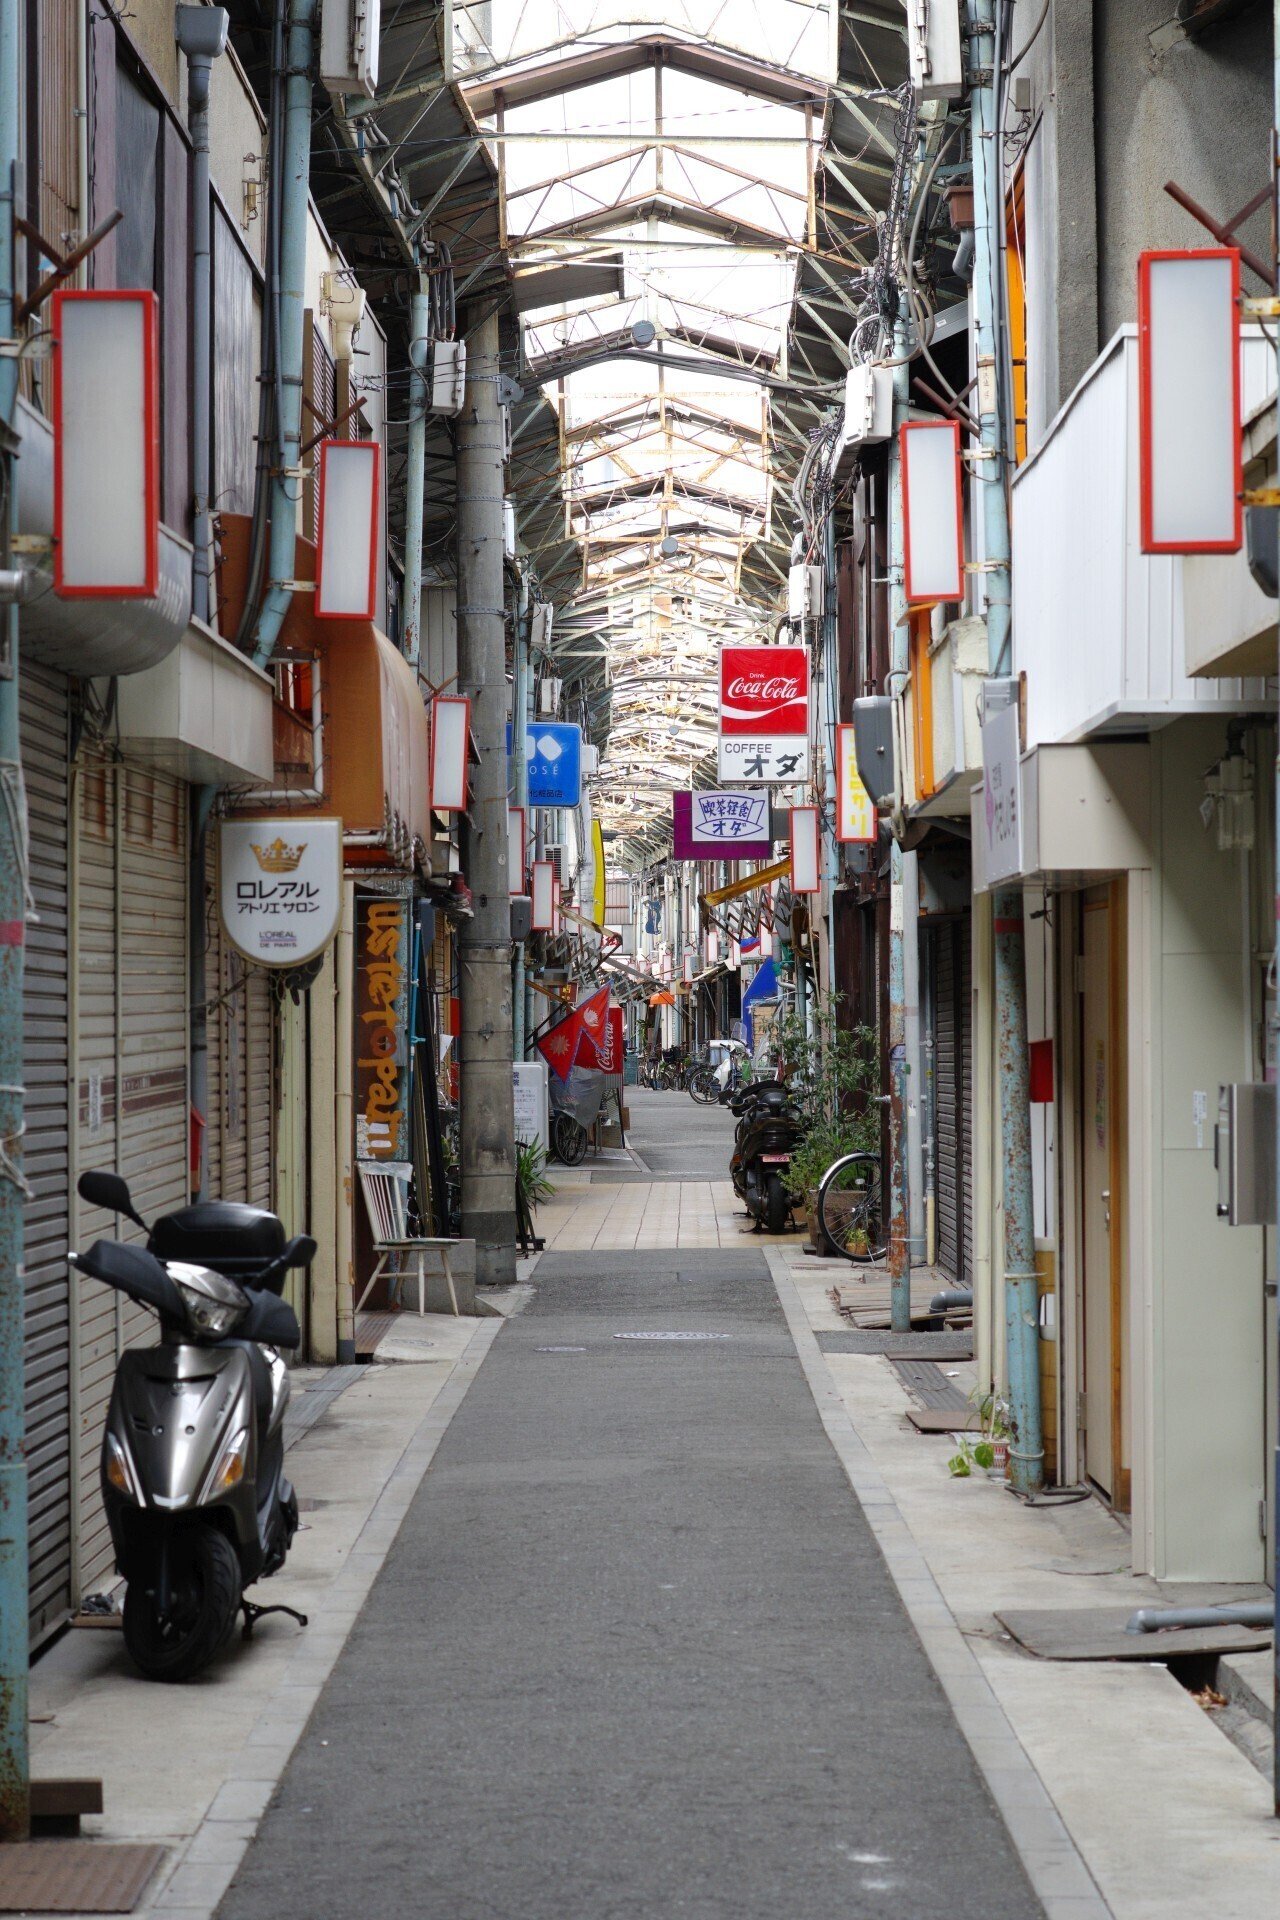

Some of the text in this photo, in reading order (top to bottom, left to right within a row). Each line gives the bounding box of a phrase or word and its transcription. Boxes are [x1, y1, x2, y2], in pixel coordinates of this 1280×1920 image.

[727, 677, 801, 699] Coca-Cola
[725, 743, 772, 753] COFFEE
[529, 764, 558, 775] OSÉ
[743, 752, 804, 777] オダ
[703, 798, 749, 817] 喫茶軽食
[713, 821, 747, 836] オダ
[237, 880, 319, 899] ロレアル
[597, 1021, 614, 1071] CocaCoa
